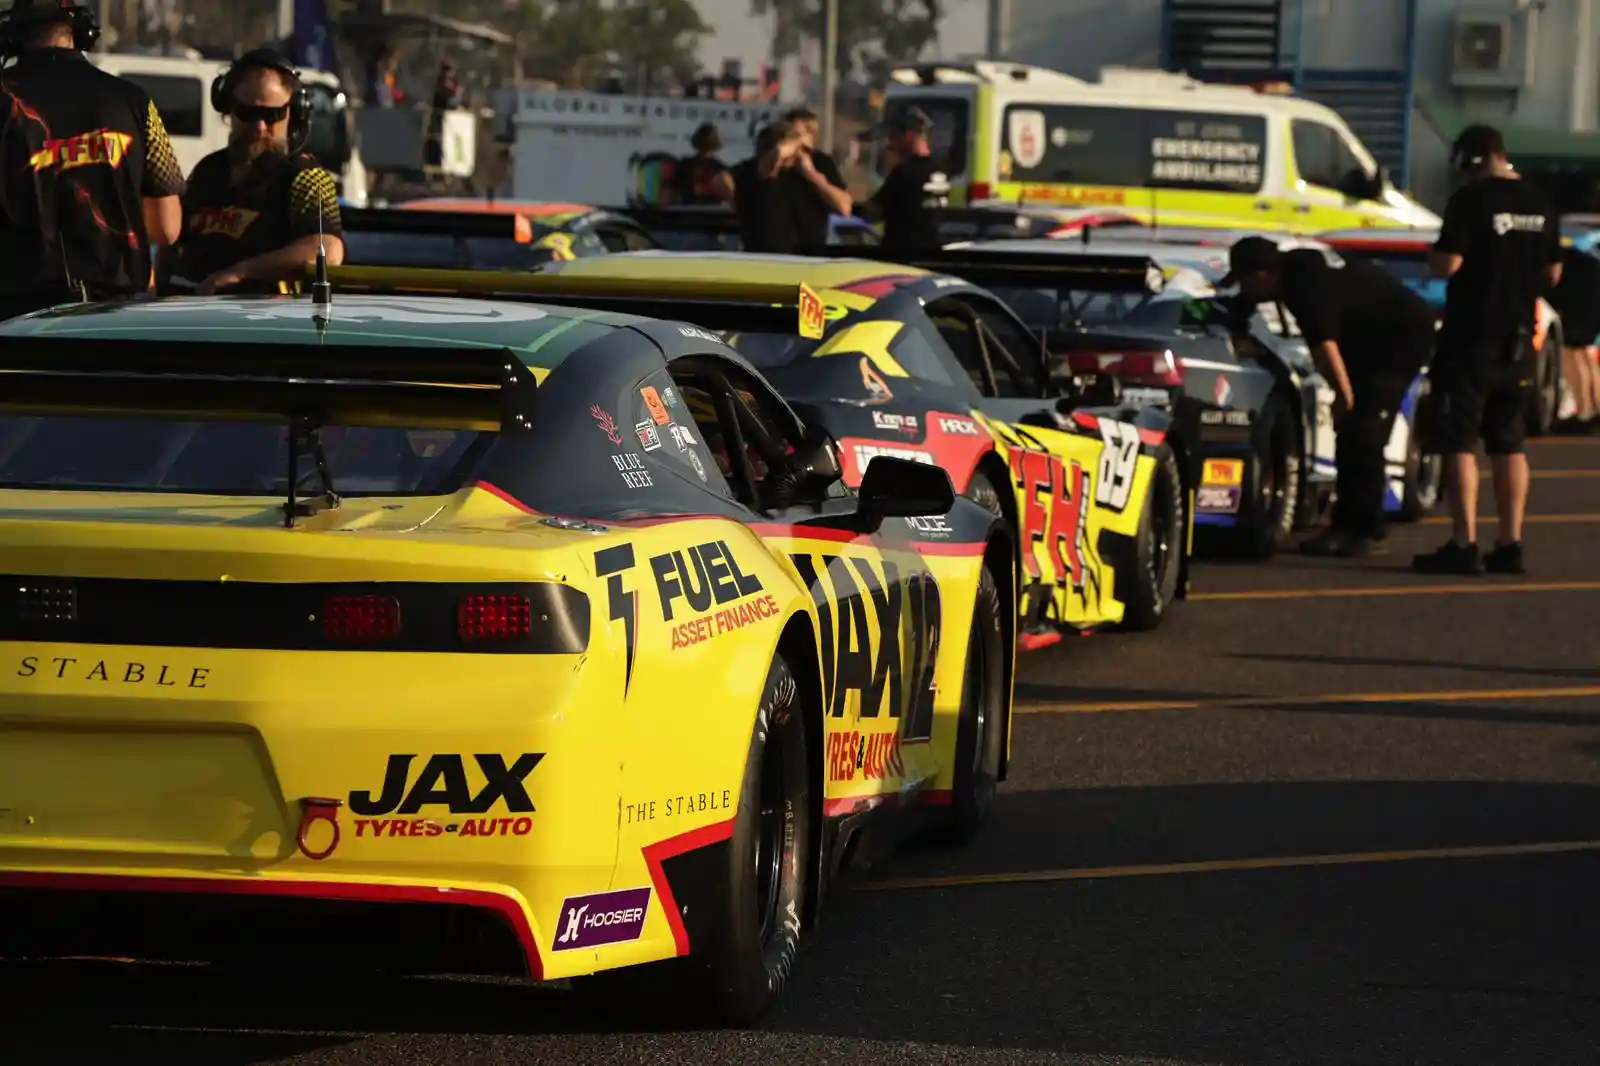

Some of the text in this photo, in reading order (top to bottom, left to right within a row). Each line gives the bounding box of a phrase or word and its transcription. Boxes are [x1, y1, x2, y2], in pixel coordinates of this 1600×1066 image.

[1151, 138, 1259, 161] EMERGENCY
[1152, 160, 1261, 184] AMBULANCE
[611, 453, 646, 471] BLUE
[621, 471, 654, 489] REEF
[649, 540, 763, 622] FUEL
[671, 595, 780, 651] ASSET FINANCE
[17, 656, 210, 688] STABLE
[348, 752, 547, 816] JAX
[626, 790, 731, 824] THE STABLE
[583, 907, 643, 930] HOOSIER
